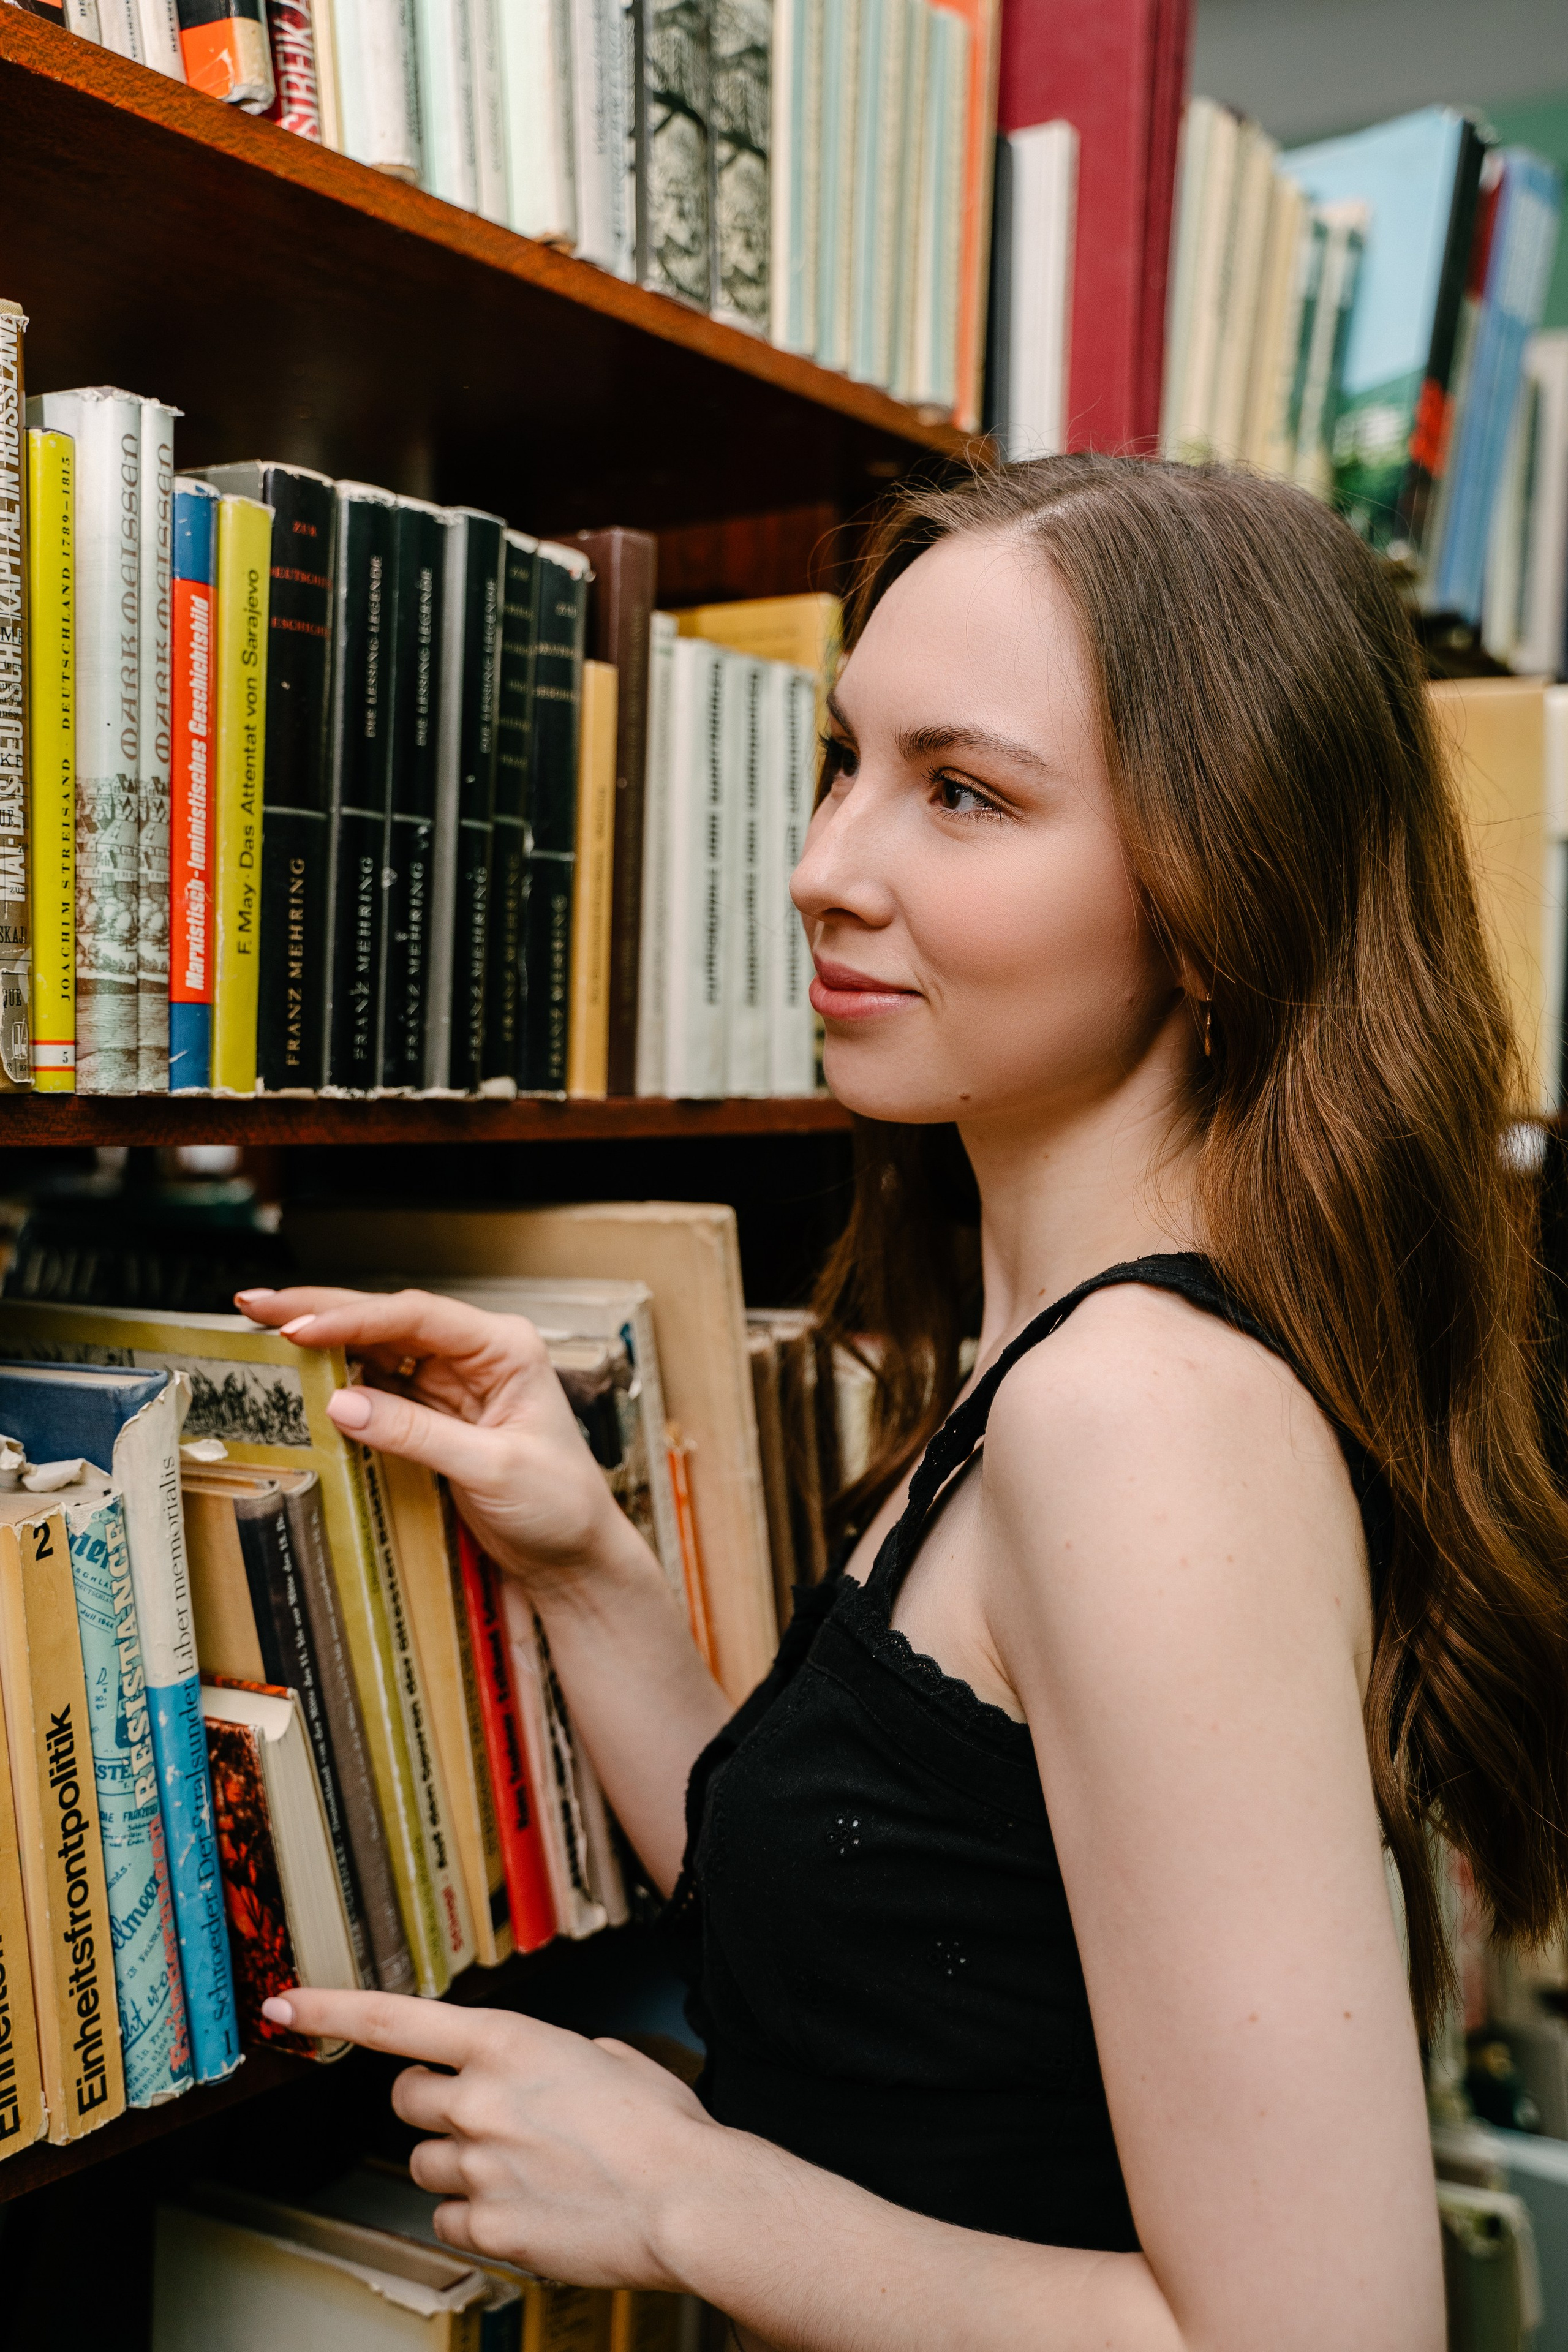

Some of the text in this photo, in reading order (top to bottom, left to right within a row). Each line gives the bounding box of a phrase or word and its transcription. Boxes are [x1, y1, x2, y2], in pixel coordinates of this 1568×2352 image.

[62, 572, 71, 731] DEUTSCHLAND
[188, 594, 210, 737] Geschichtsbild
[242, 568, 261, 667] Sarajevo
[245, 676, 258, 717] von
[241, 723, 258, 816] Attentat
[239, 825, 255, 869] Das
[61, 902, 70, 1001] JOACHIM
[238, 883, 257, 933] May
[356, 857, 374, 973] MEHRING
[285, 858, 305, 1066] FRANZ MEHRING
[404, 861, 424, 1061] FRANZ MEHRING
[62, 1051, 68, 1063] 5
[32, 1520, 54, 1562] 2
[159, 1456, 190, 1600] memorialis
[174, 1608, 195, 1675] Liber
[197, 1835, 215, 1881] Der
[45, 1703, 108, 2116] Einheitsfrontpolitik
[201, 1896, 232, 2021] Schroeder
